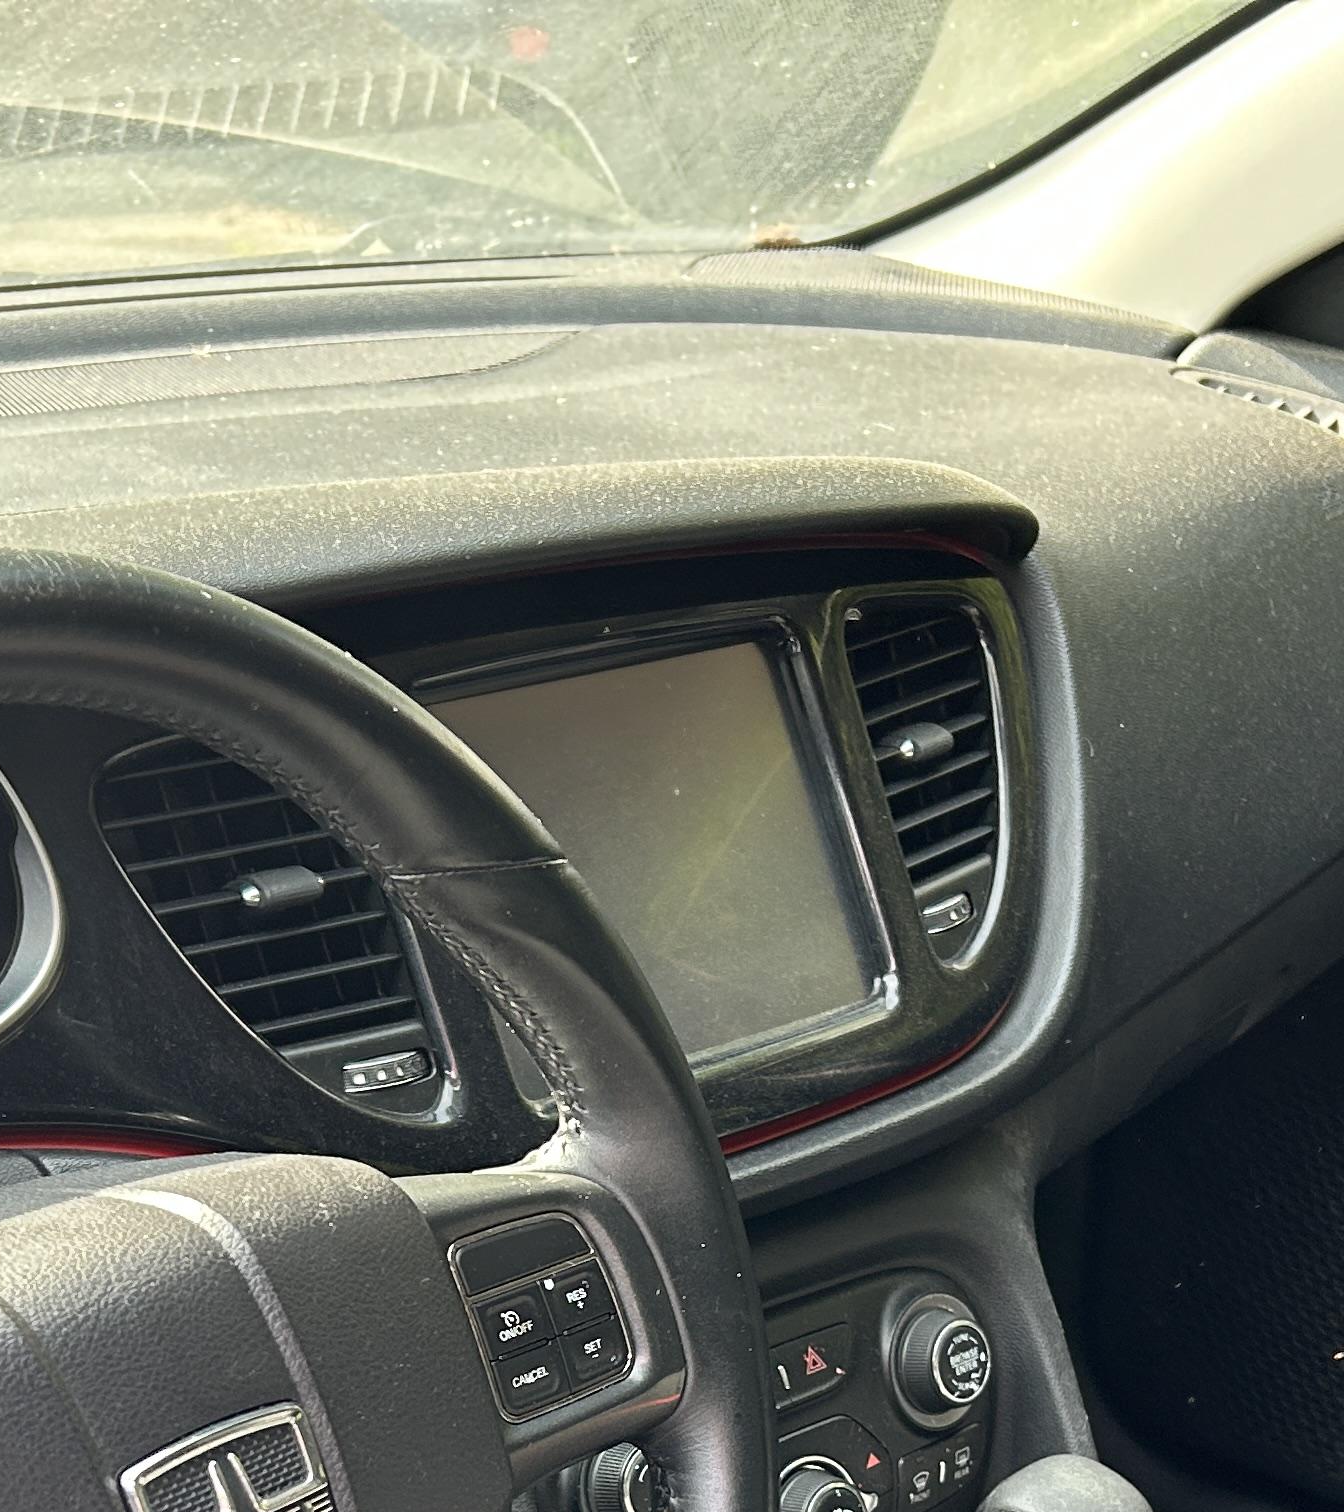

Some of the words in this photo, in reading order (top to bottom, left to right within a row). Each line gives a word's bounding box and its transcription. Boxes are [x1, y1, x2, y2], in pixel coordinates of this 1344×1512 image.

[566, 1288, 587, 1304] RES
[499, 1320, 534, 1342] ON/OFF
[584, 1338, 602, 1355] SET
[512, 1366, 549, 1389] CANCEL
